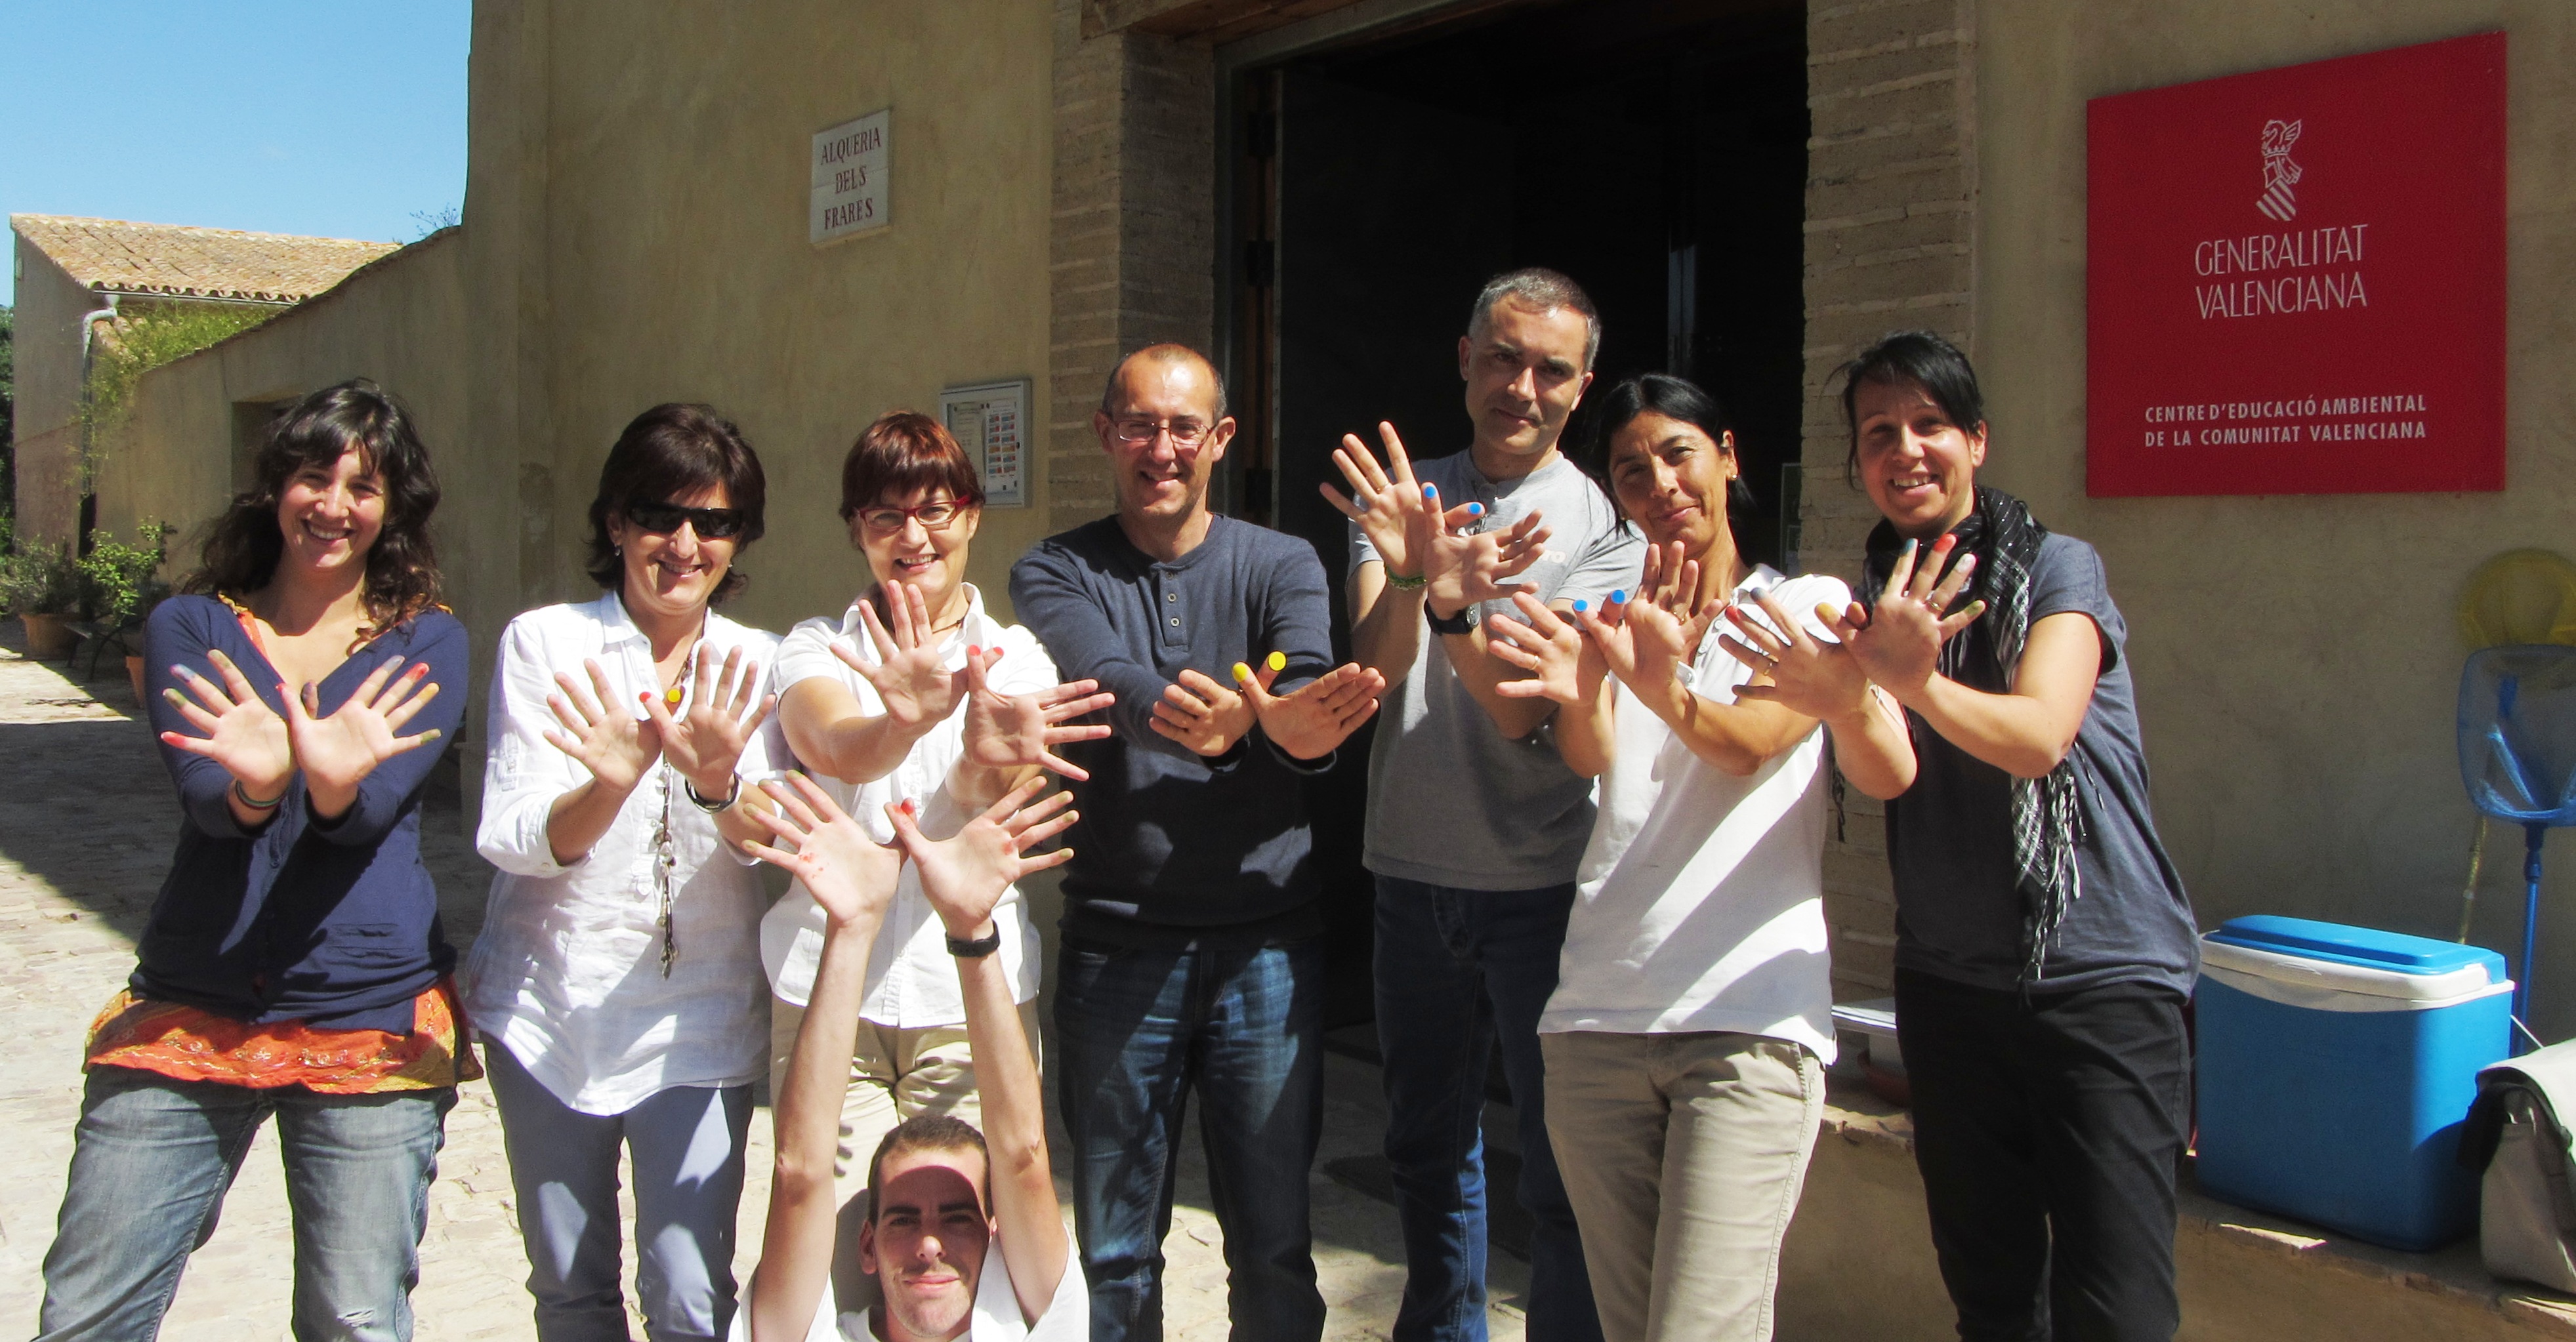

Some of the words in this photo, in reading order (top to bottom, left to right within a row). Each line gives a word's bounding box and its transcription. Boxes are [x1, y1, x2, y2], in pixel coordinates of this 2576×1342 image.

[820, 127, 882, 165] ALQUERIA
[834, 165, 867, 195] DELS
[823, 197, 873, 231] FRARES
[2195, 224, 2368, 276] GENERALITAT
[2195, 272, 2367, 319] VALENCIANA
[2145, 404, 2205, 423] CENTRE
[2321, 394, 2426, 415] AMBIENTAL
[2145, 431, 2165, 447] DE
[2173, 430, 2192, 446] LA
[2200, 426, 2300, 445] COMUNITAT
[2309, 421, 2426, 441] VALENCIANA
